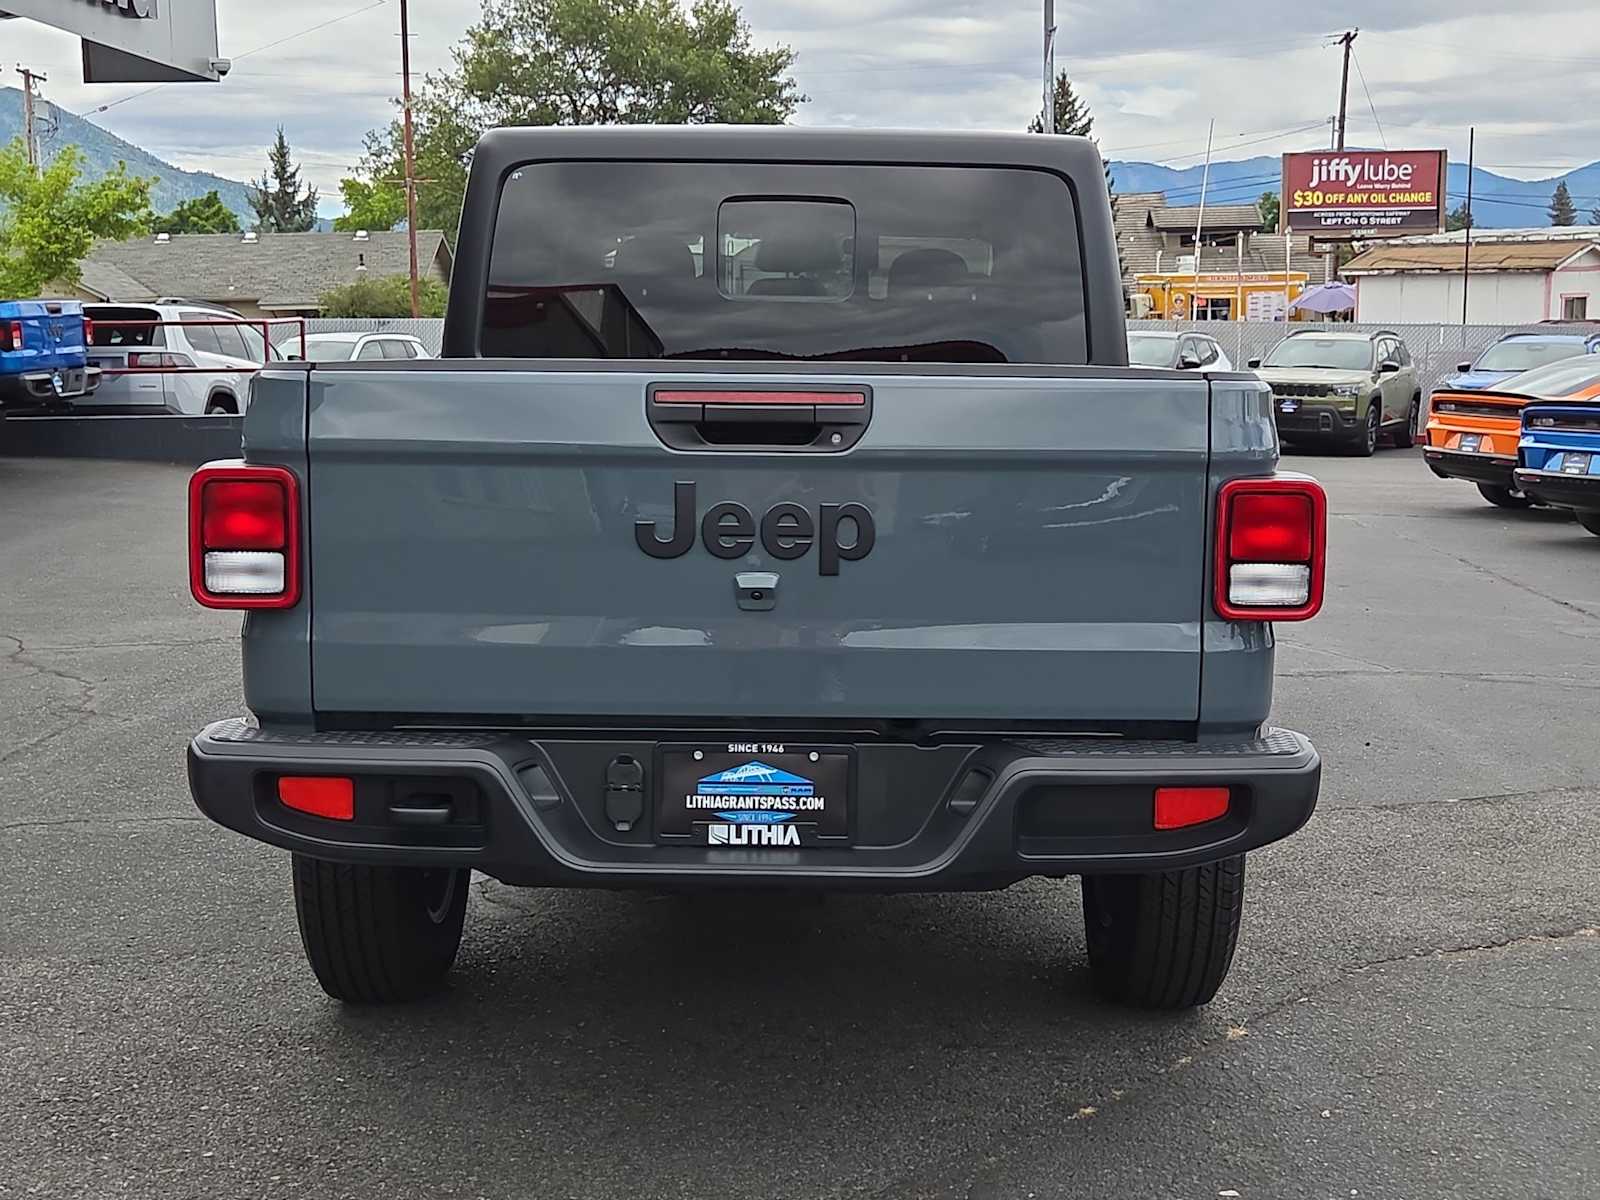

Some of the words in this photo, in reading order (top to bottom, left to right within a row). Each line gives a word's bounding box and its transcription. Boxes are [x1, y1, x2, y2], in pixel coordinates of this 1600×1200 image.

[1293, 190, 1323, 207] $30
[1325, 193, 1345, 203] OFF
[1347, 193, 1368, 203] ANY
[1370, 192, 1387, 203] OIL
[1389, 192, 1432, 203] CHANGE
[634, 480, 876, 577] Jeep
[727, 744, 759, 753] SINCE
[761, 744, 785, 753] 1946
[686, 795, 825, 810] LITHIAGRANTSPASS.COM
[729, 824, 801, 845] LITHIA
